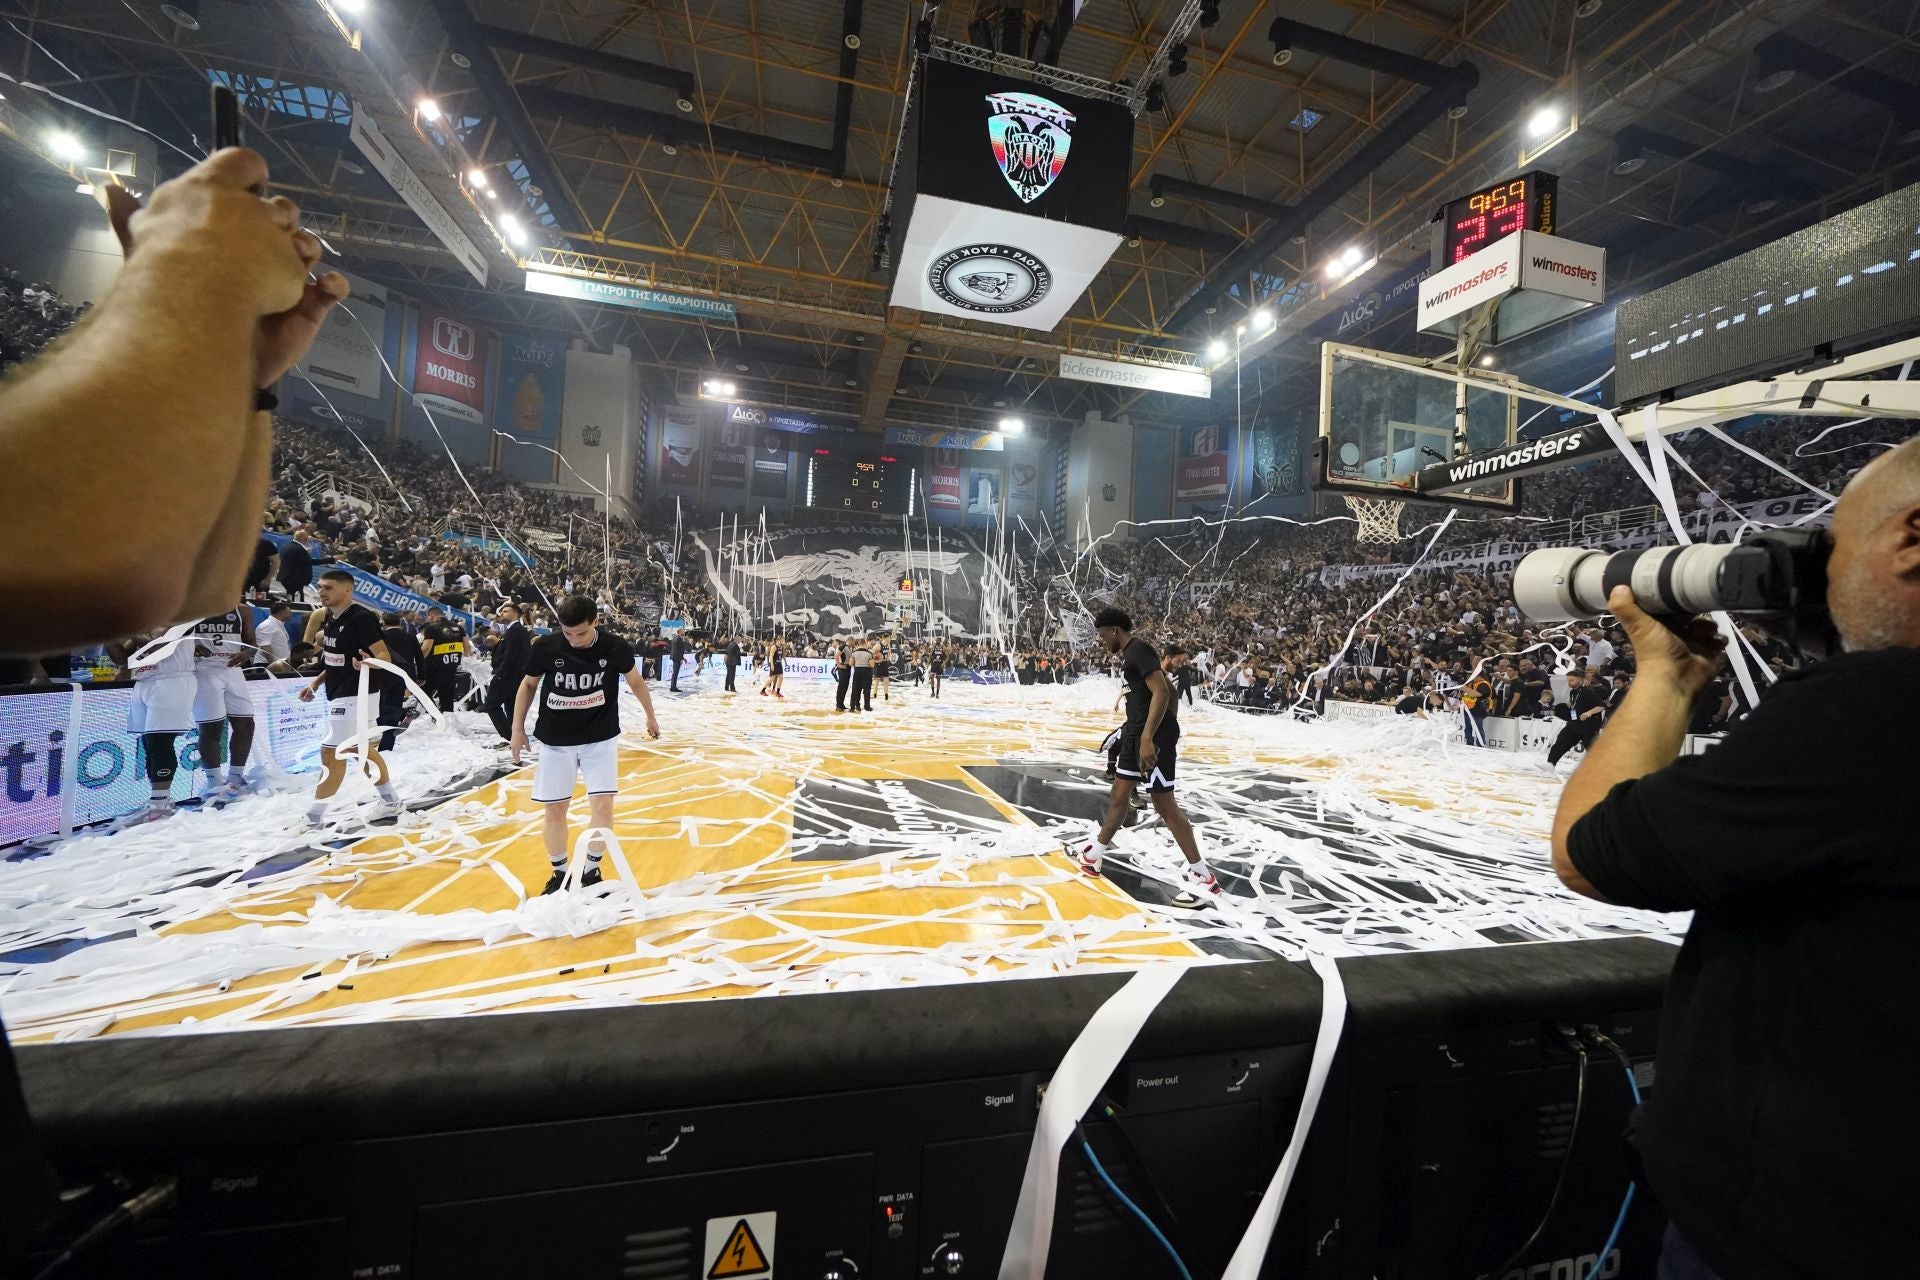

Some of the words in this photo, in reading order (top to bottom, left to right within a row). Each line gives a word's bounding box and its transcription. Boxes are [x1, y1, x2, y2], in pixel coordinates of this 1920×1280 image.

[1469, 179, 1526, 213] 9:59
[1539, 192, 1552, 234] Quince
[1532, 256, 1597, 282] winmasters
[1425, 260, 1509, 310] winmasters
[584, 280, 628, 298] ΓΙΑΤΡΟΙ
[630, 289, 651, 301] ΤΗΣ
[653, 292, 734, 313] ΚΑΘΑΡΙΟΤΗΤΑΣ
[426, 362, 476, 389] MORRIS
[1449, 432, 1582, 483] winmasters
[199, 623, 234, 634] PAOK
[212, 633, 224, 647] 2
[554, 671, 605, 691] PAOK
[548, 694, 604, 707] winmasters
[1137, 1078, 1163, 1088] Power
[1165, 1076, 1179, 1086] out
[984, 1093, 1014, 1107] Signal
[879, 1194, 894, 1203] PWR
[896, 1192, 914, 1201] DATA
[888, 1212, 904, 1222] TEST
